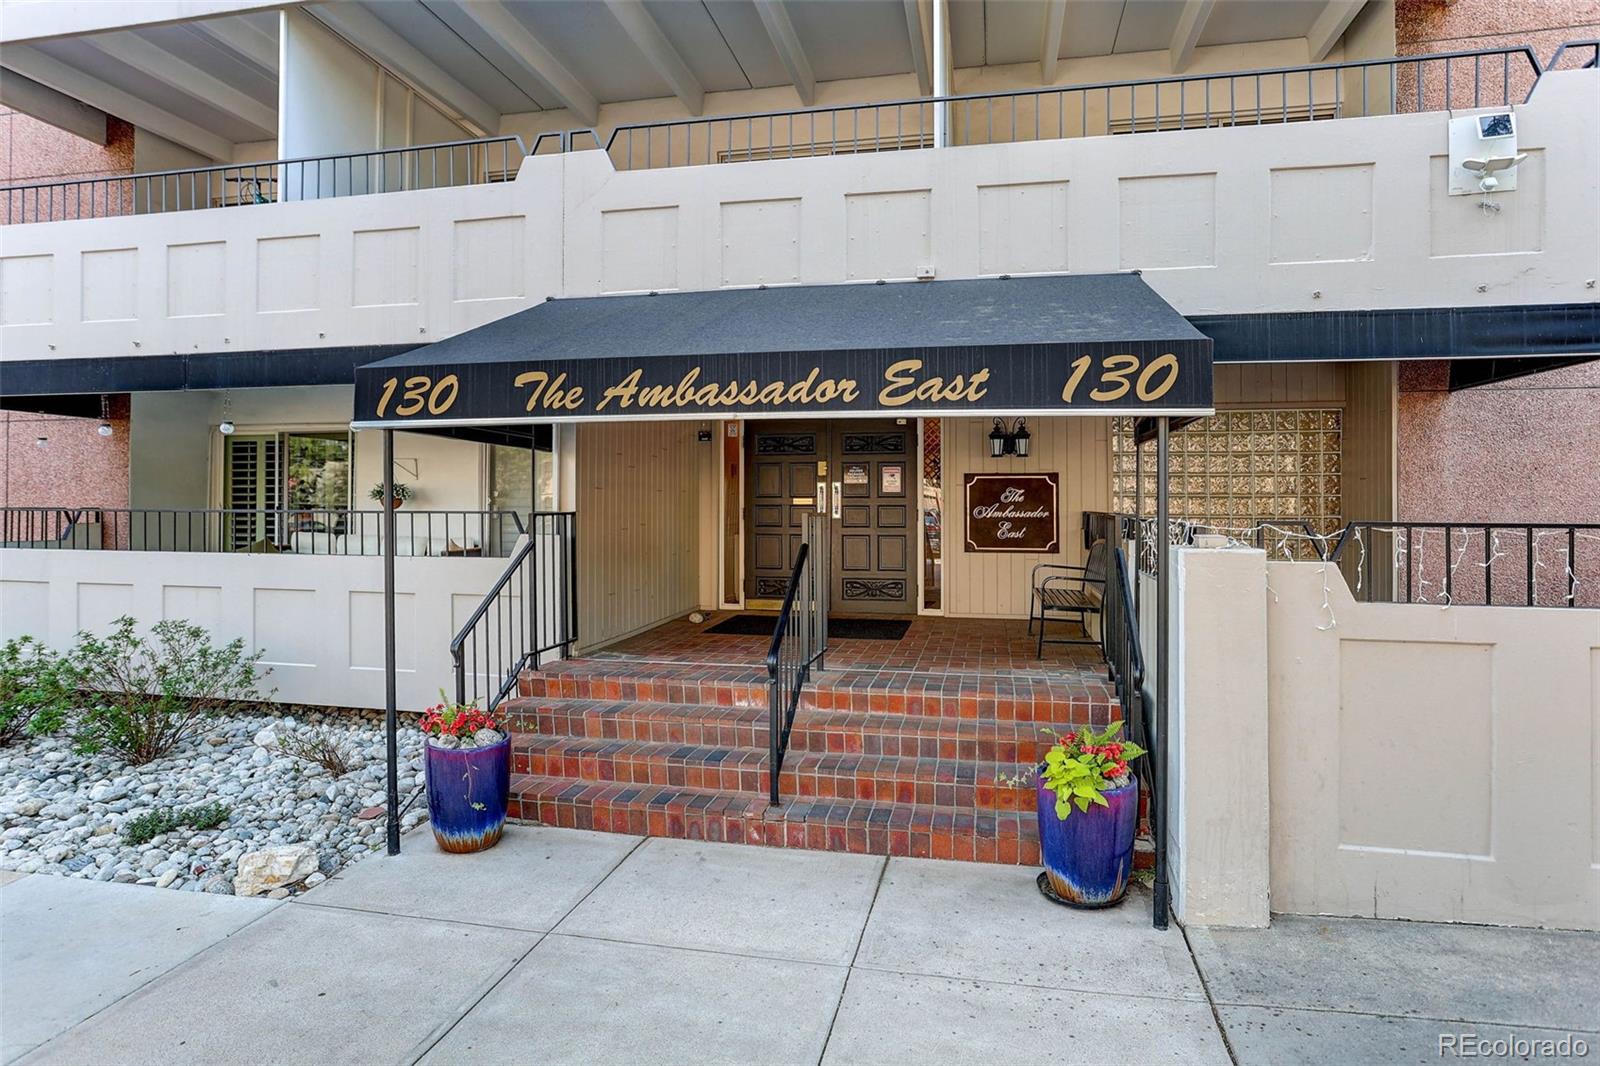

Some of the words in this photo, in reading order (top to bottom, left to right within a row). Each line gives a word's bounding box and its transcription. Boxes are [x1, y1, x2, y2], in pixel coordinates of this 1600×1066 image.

[513, 371, 584, 412] The
[596, 367, 861, 412] Ambassador
[878, 359, 990, 407] East
[1062, 354, 1180, 404] 130
[376, 374, 459, 418] 130
[1000, 486, 1025, 503] The
[973, 503, 1050, 519] Ambassador
[997, 520, 1027, 540] East
